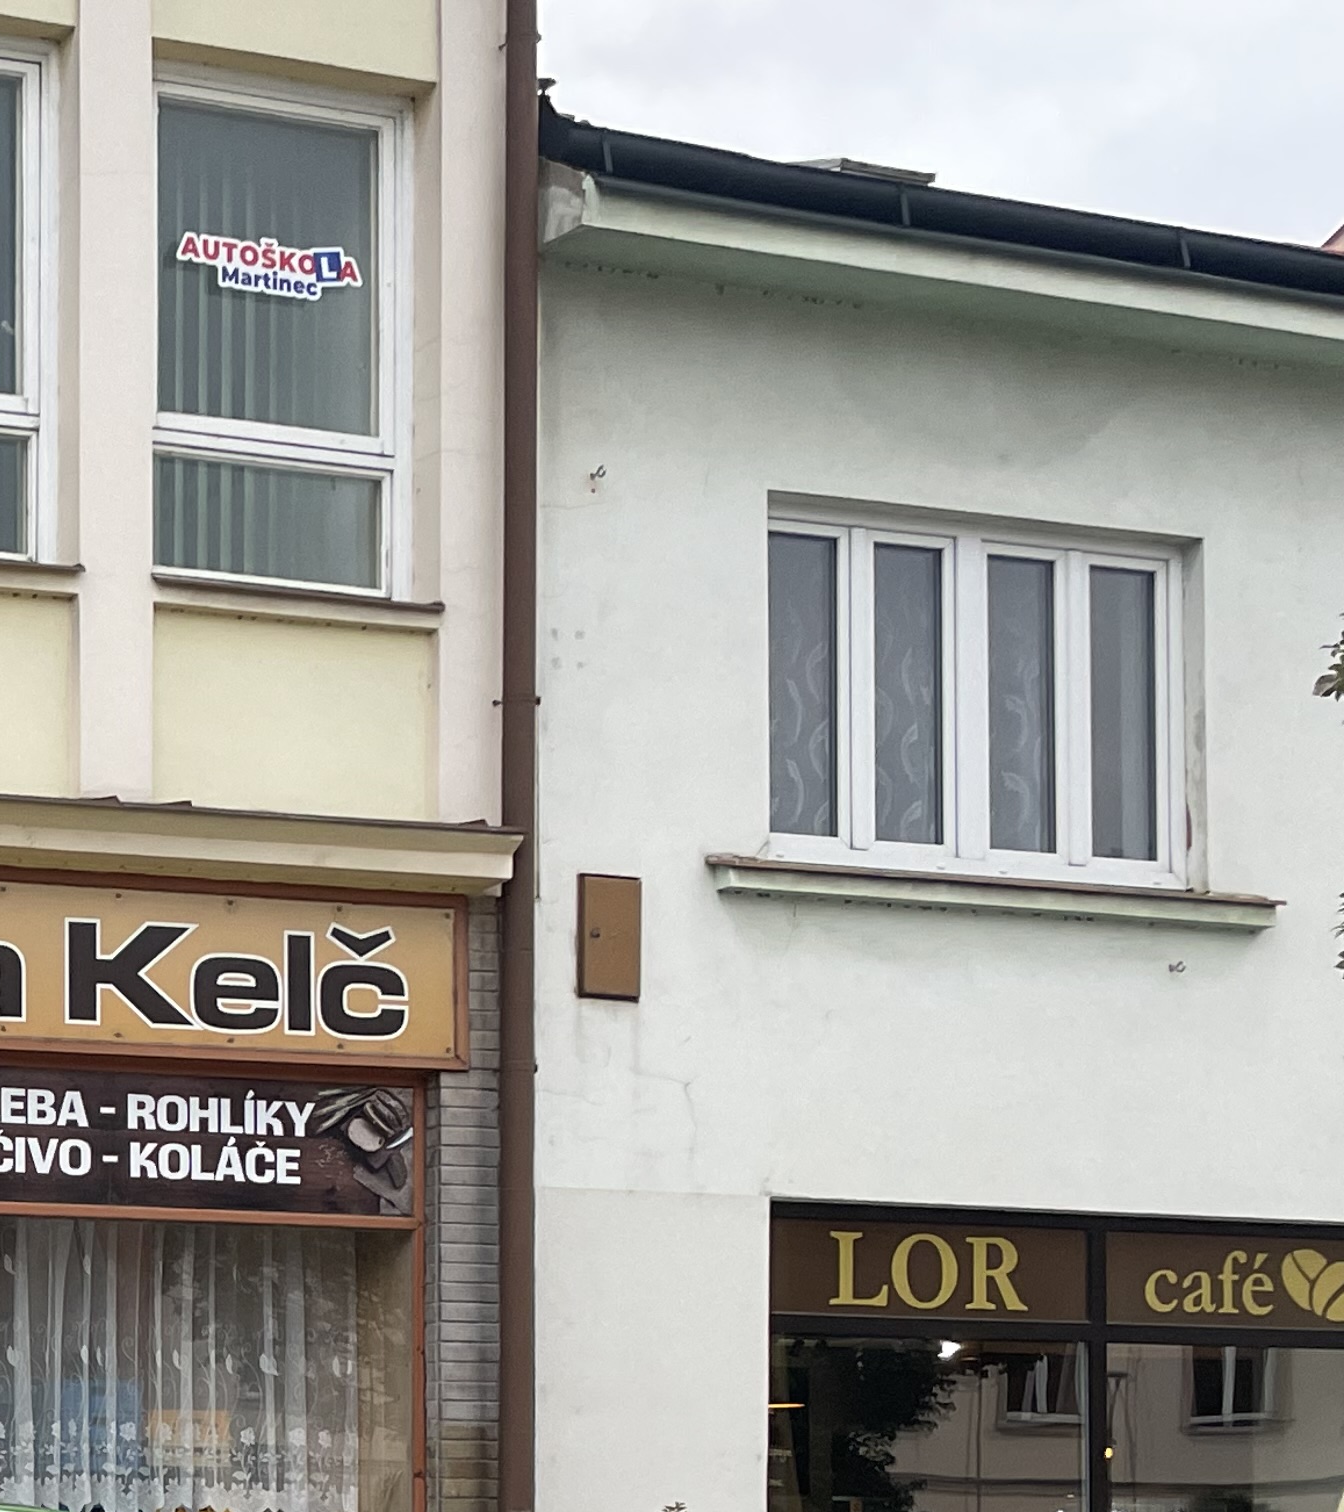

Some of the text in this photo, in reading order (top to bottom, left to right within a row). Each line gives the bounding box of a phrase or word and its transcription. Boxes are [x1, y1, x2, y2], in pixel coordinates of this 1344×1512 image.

[181, 236, 358, 282] AUTOŠKOLA
[221, 266, 318, 296] Martinec
[65, 915, 410, 1039] Kelč
[127, 1090, 316, 1138] ROHLÍKY
[129, 1138, 302, 1185] KOLÁČE
[829, 1230, 1028, 1312] LOR
[1145, 1250, 1275, 1316] café
